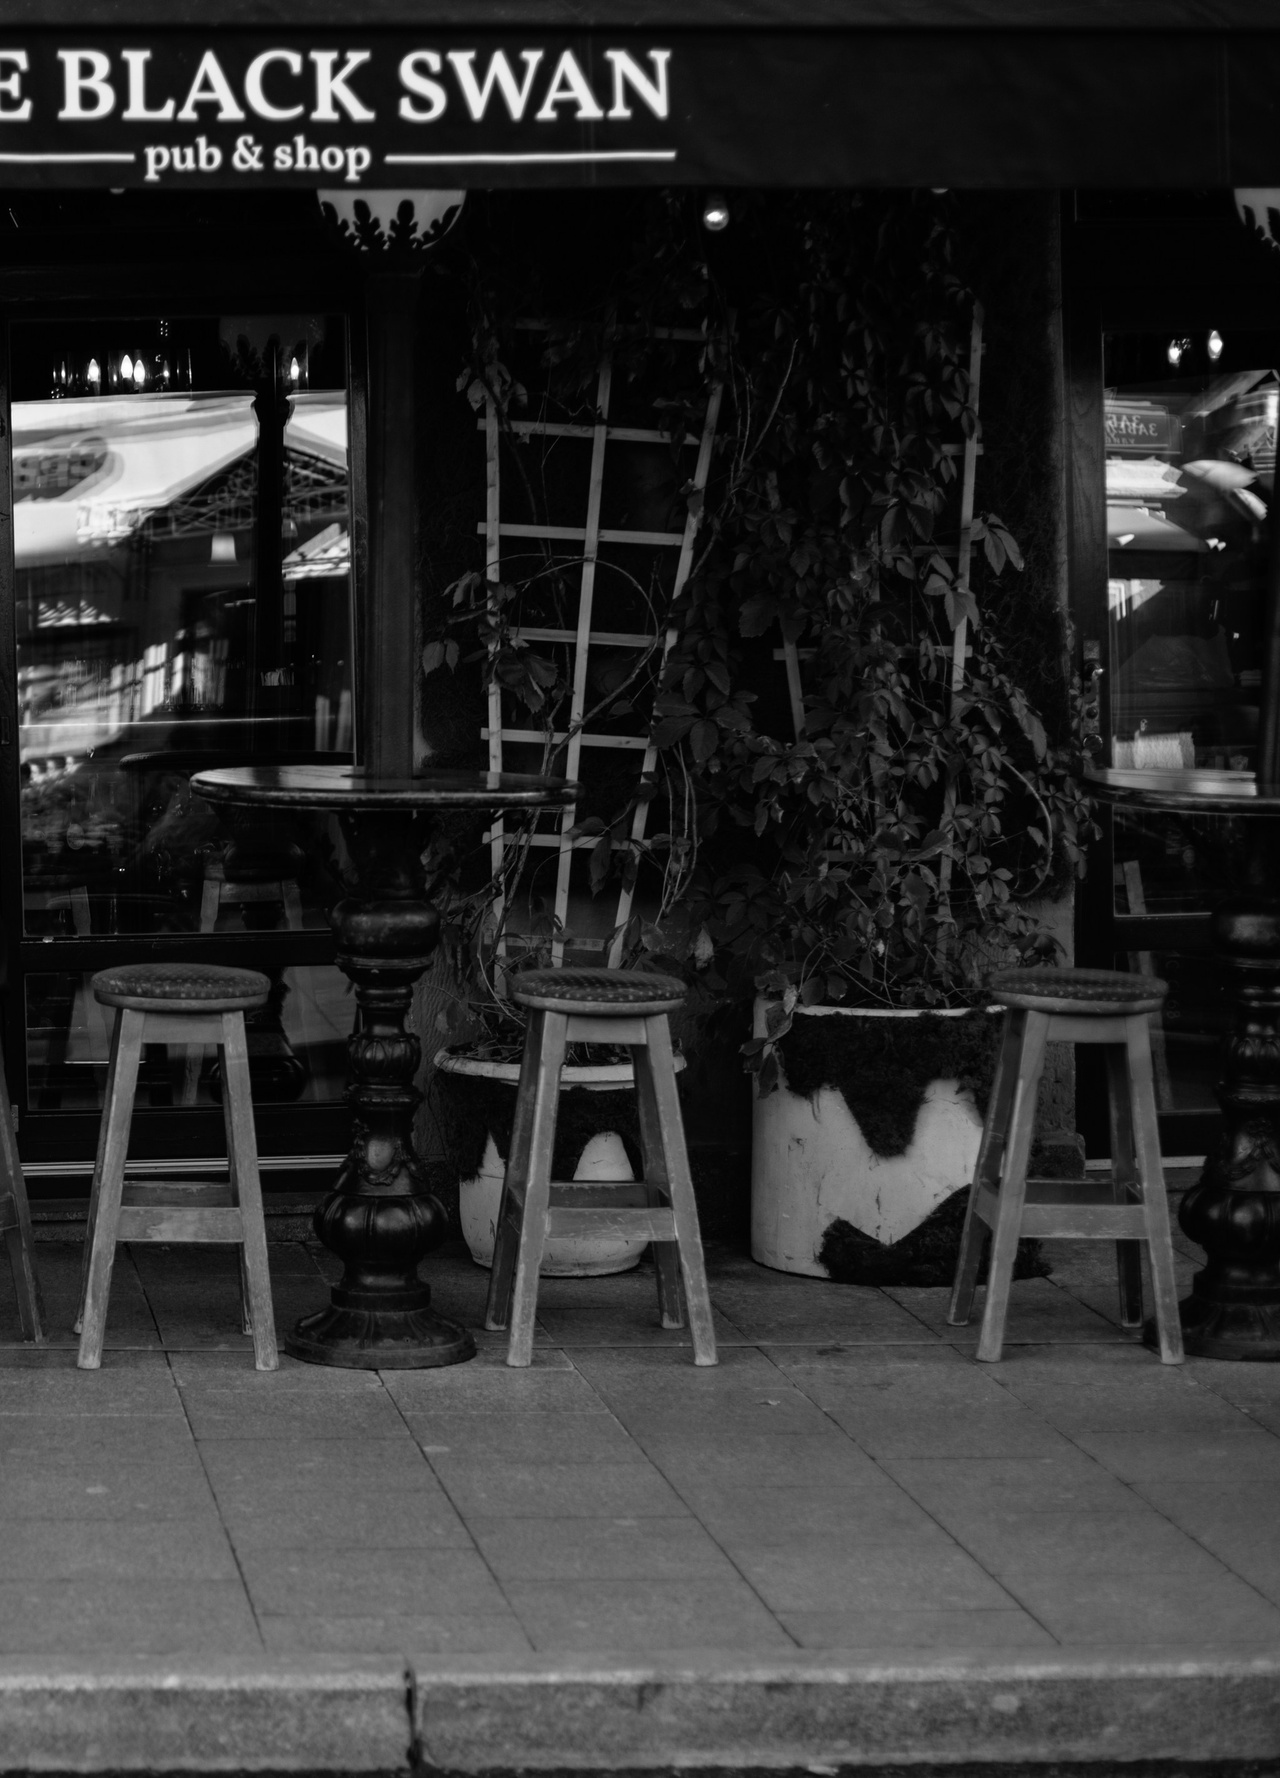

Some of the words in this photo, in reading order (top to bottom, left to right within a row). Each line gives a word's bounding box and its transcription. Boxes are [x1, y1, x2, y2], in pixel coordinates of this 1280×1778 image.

[57, 49, 376, 122] BLACK
[399, 49, 672, 122] SWAN
[144, 136, 222, 181] pub
[231, 135, 264, 171] &
[273, 135, 372, 181] shop
